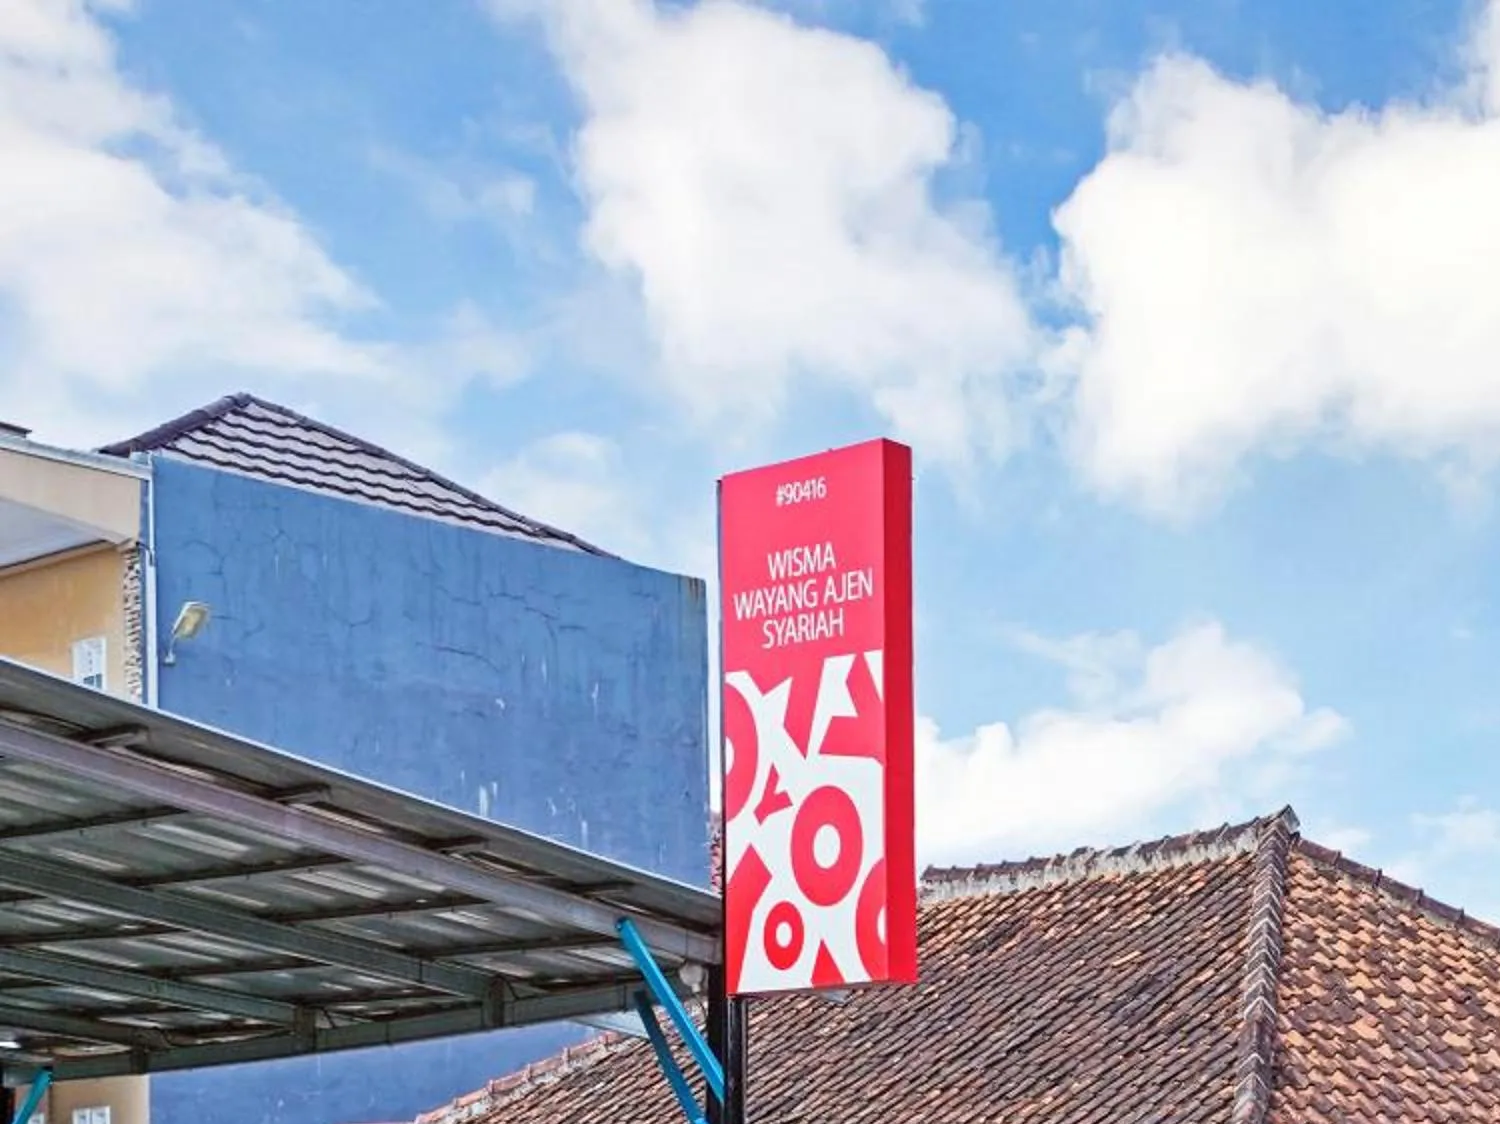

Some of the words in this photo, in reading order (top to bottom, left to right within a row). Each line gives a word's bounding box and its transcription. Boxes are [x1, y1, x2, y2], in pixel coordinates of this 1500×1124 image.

[776, 477, 828, 506] #90416
[768, 542, 836, 581] WISMA
[733, 580, 818, 620] WAYANG
[823, 568, 873, 605] AJEN
[762, 607, 844, 649] SYARIAH
